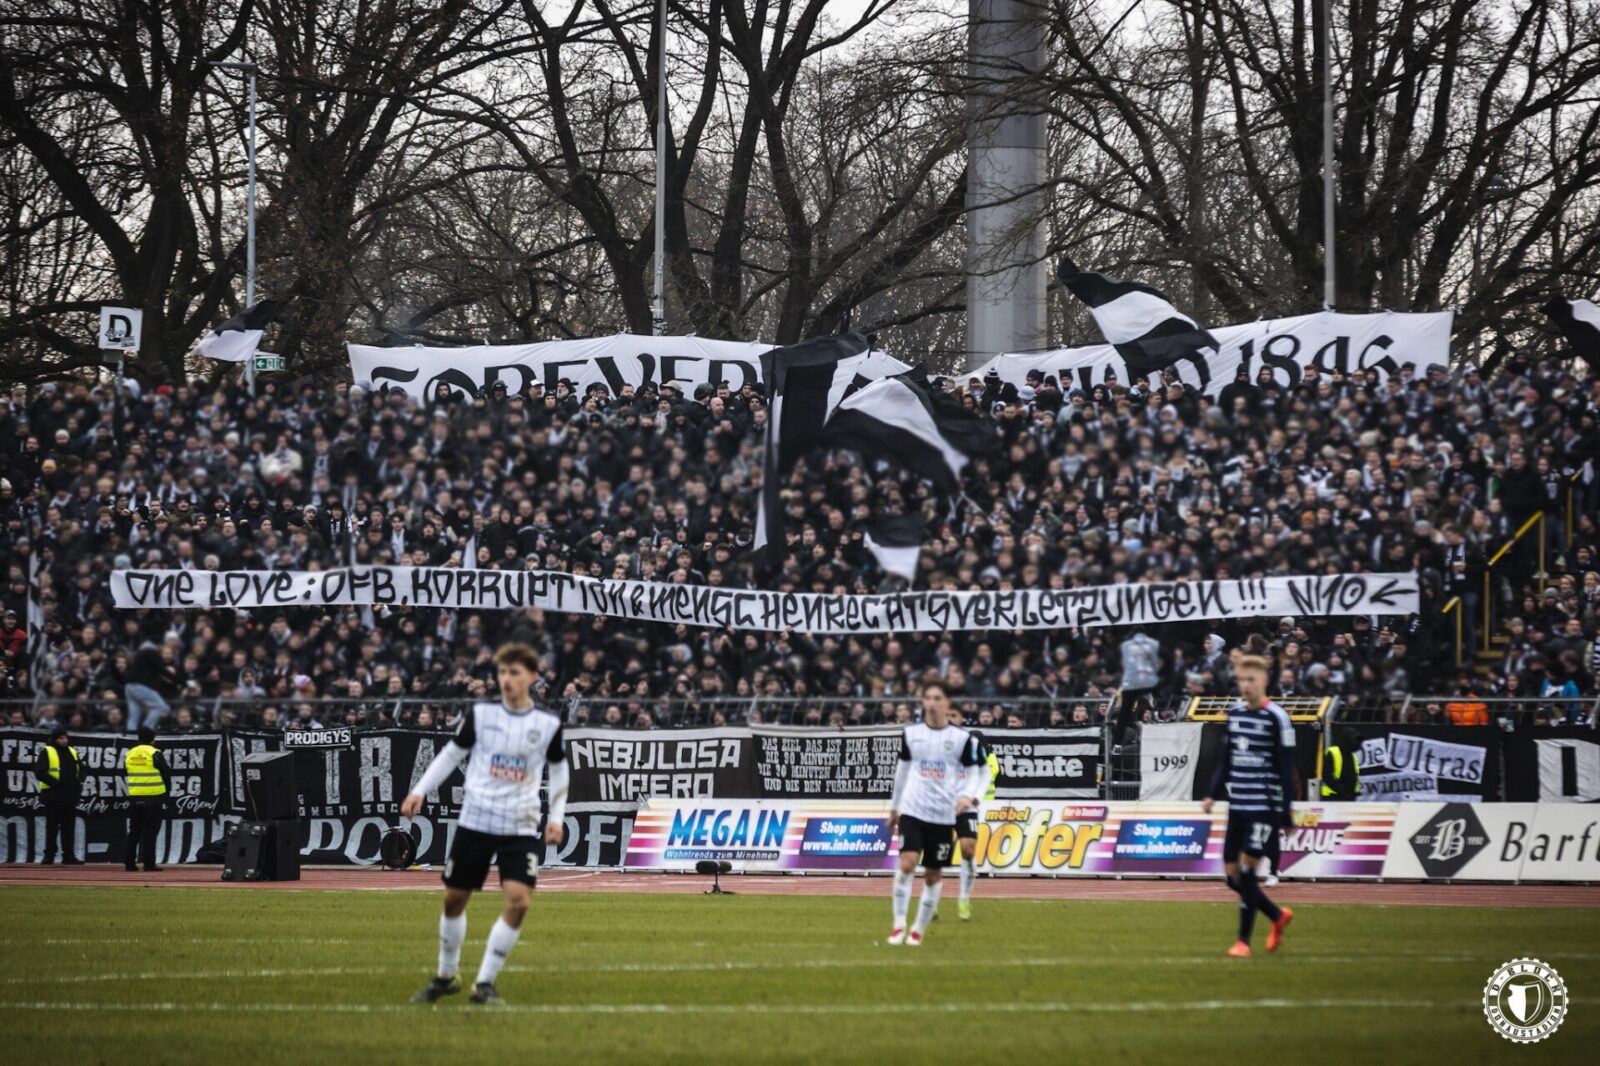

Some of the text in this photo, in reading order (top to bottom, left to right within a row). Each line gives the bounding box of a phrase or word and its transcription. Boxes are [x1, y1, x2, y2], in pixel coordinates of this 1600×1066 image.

[109, 314, 132, 342] D
[287, 730, 349, 745] PRODIGYS
[761, 738, 902, 752] DAS ZIEL DAS IST EINE KURV
[2, 739, 48, 764] FES
[571, 739, 741, 770] NEBULOSA
[800, 752, 841, 765] MINUTEN
[845, 752, 870, 765] LANG
[1390, 737, 1482, 781] Ultras
[1152, 755, 1189, 772] 1999
[791, 766, 831, 779] MINUTEN
[835, 767, 850, 779] AM
[169, 776, 202, 797] EG
[599, 773, 714, 800] IMPERO
[764, 778, 782, 791] UND
[785, 780, 800, 792] DIE
[804, 780, 822, 793] DEN
[1359, 775, 1436, 795] ewinnen
[985, 806, 1031, 821] möbel
[668, 808, 790, 847] MEGAIN
[820, 822, 878, 835] Shop unter
[1133, 824, 1195, 838] Shop unter
[803, 839, 886, 851] www.inhofer.de
[1116, 842, 1203, 855] www.inhofer.de
[1500, 821, 1600, 862] Barf
